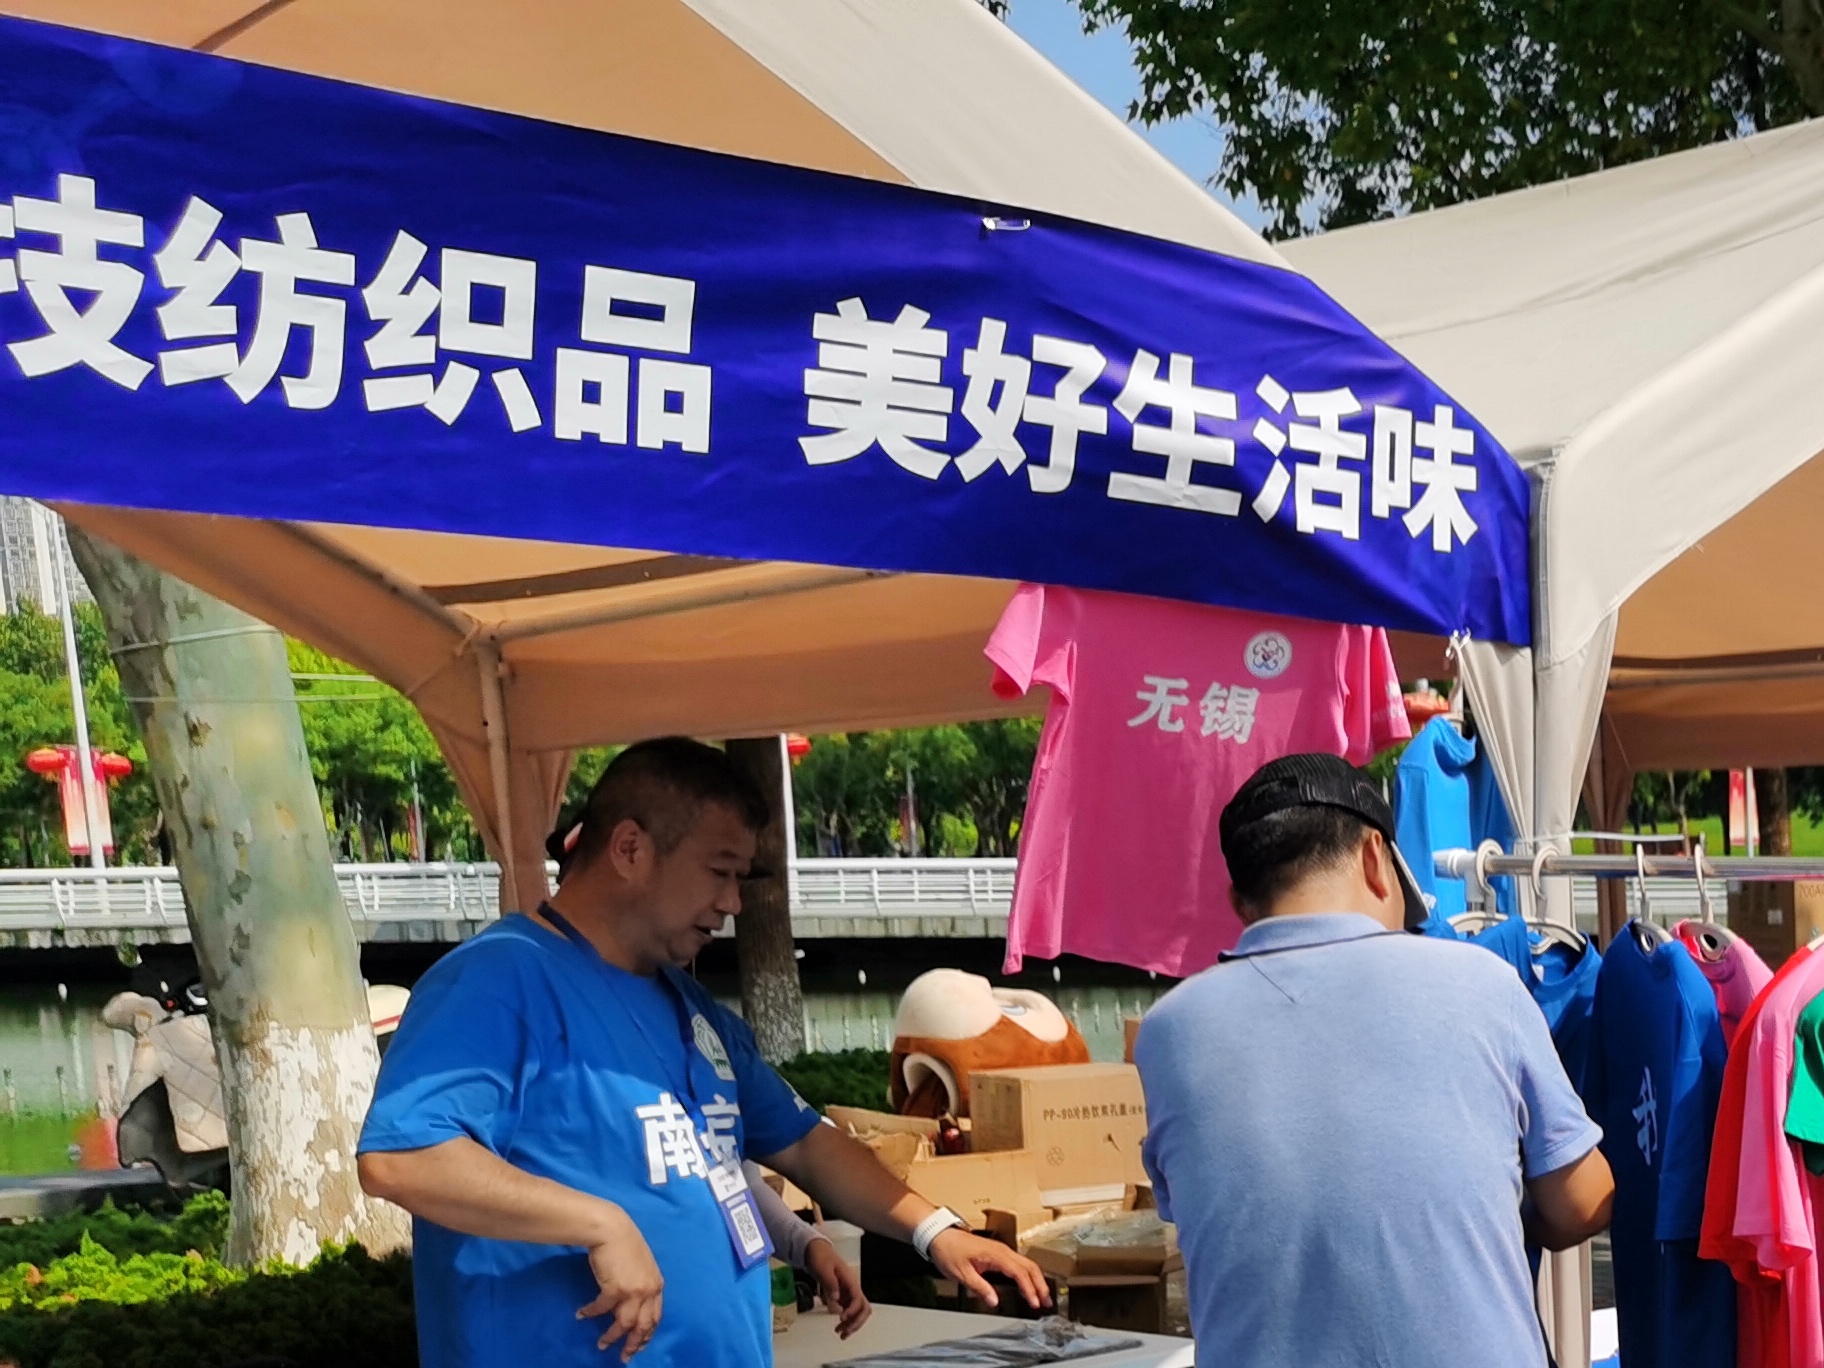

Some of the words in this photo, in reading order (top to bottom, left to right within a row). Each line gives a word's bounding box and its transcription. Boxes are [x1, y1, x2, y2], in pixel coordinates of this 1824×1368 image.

[797, 297, 1480, 553] 美好生活味
[1127, 673, 1260, 745] 无锡
